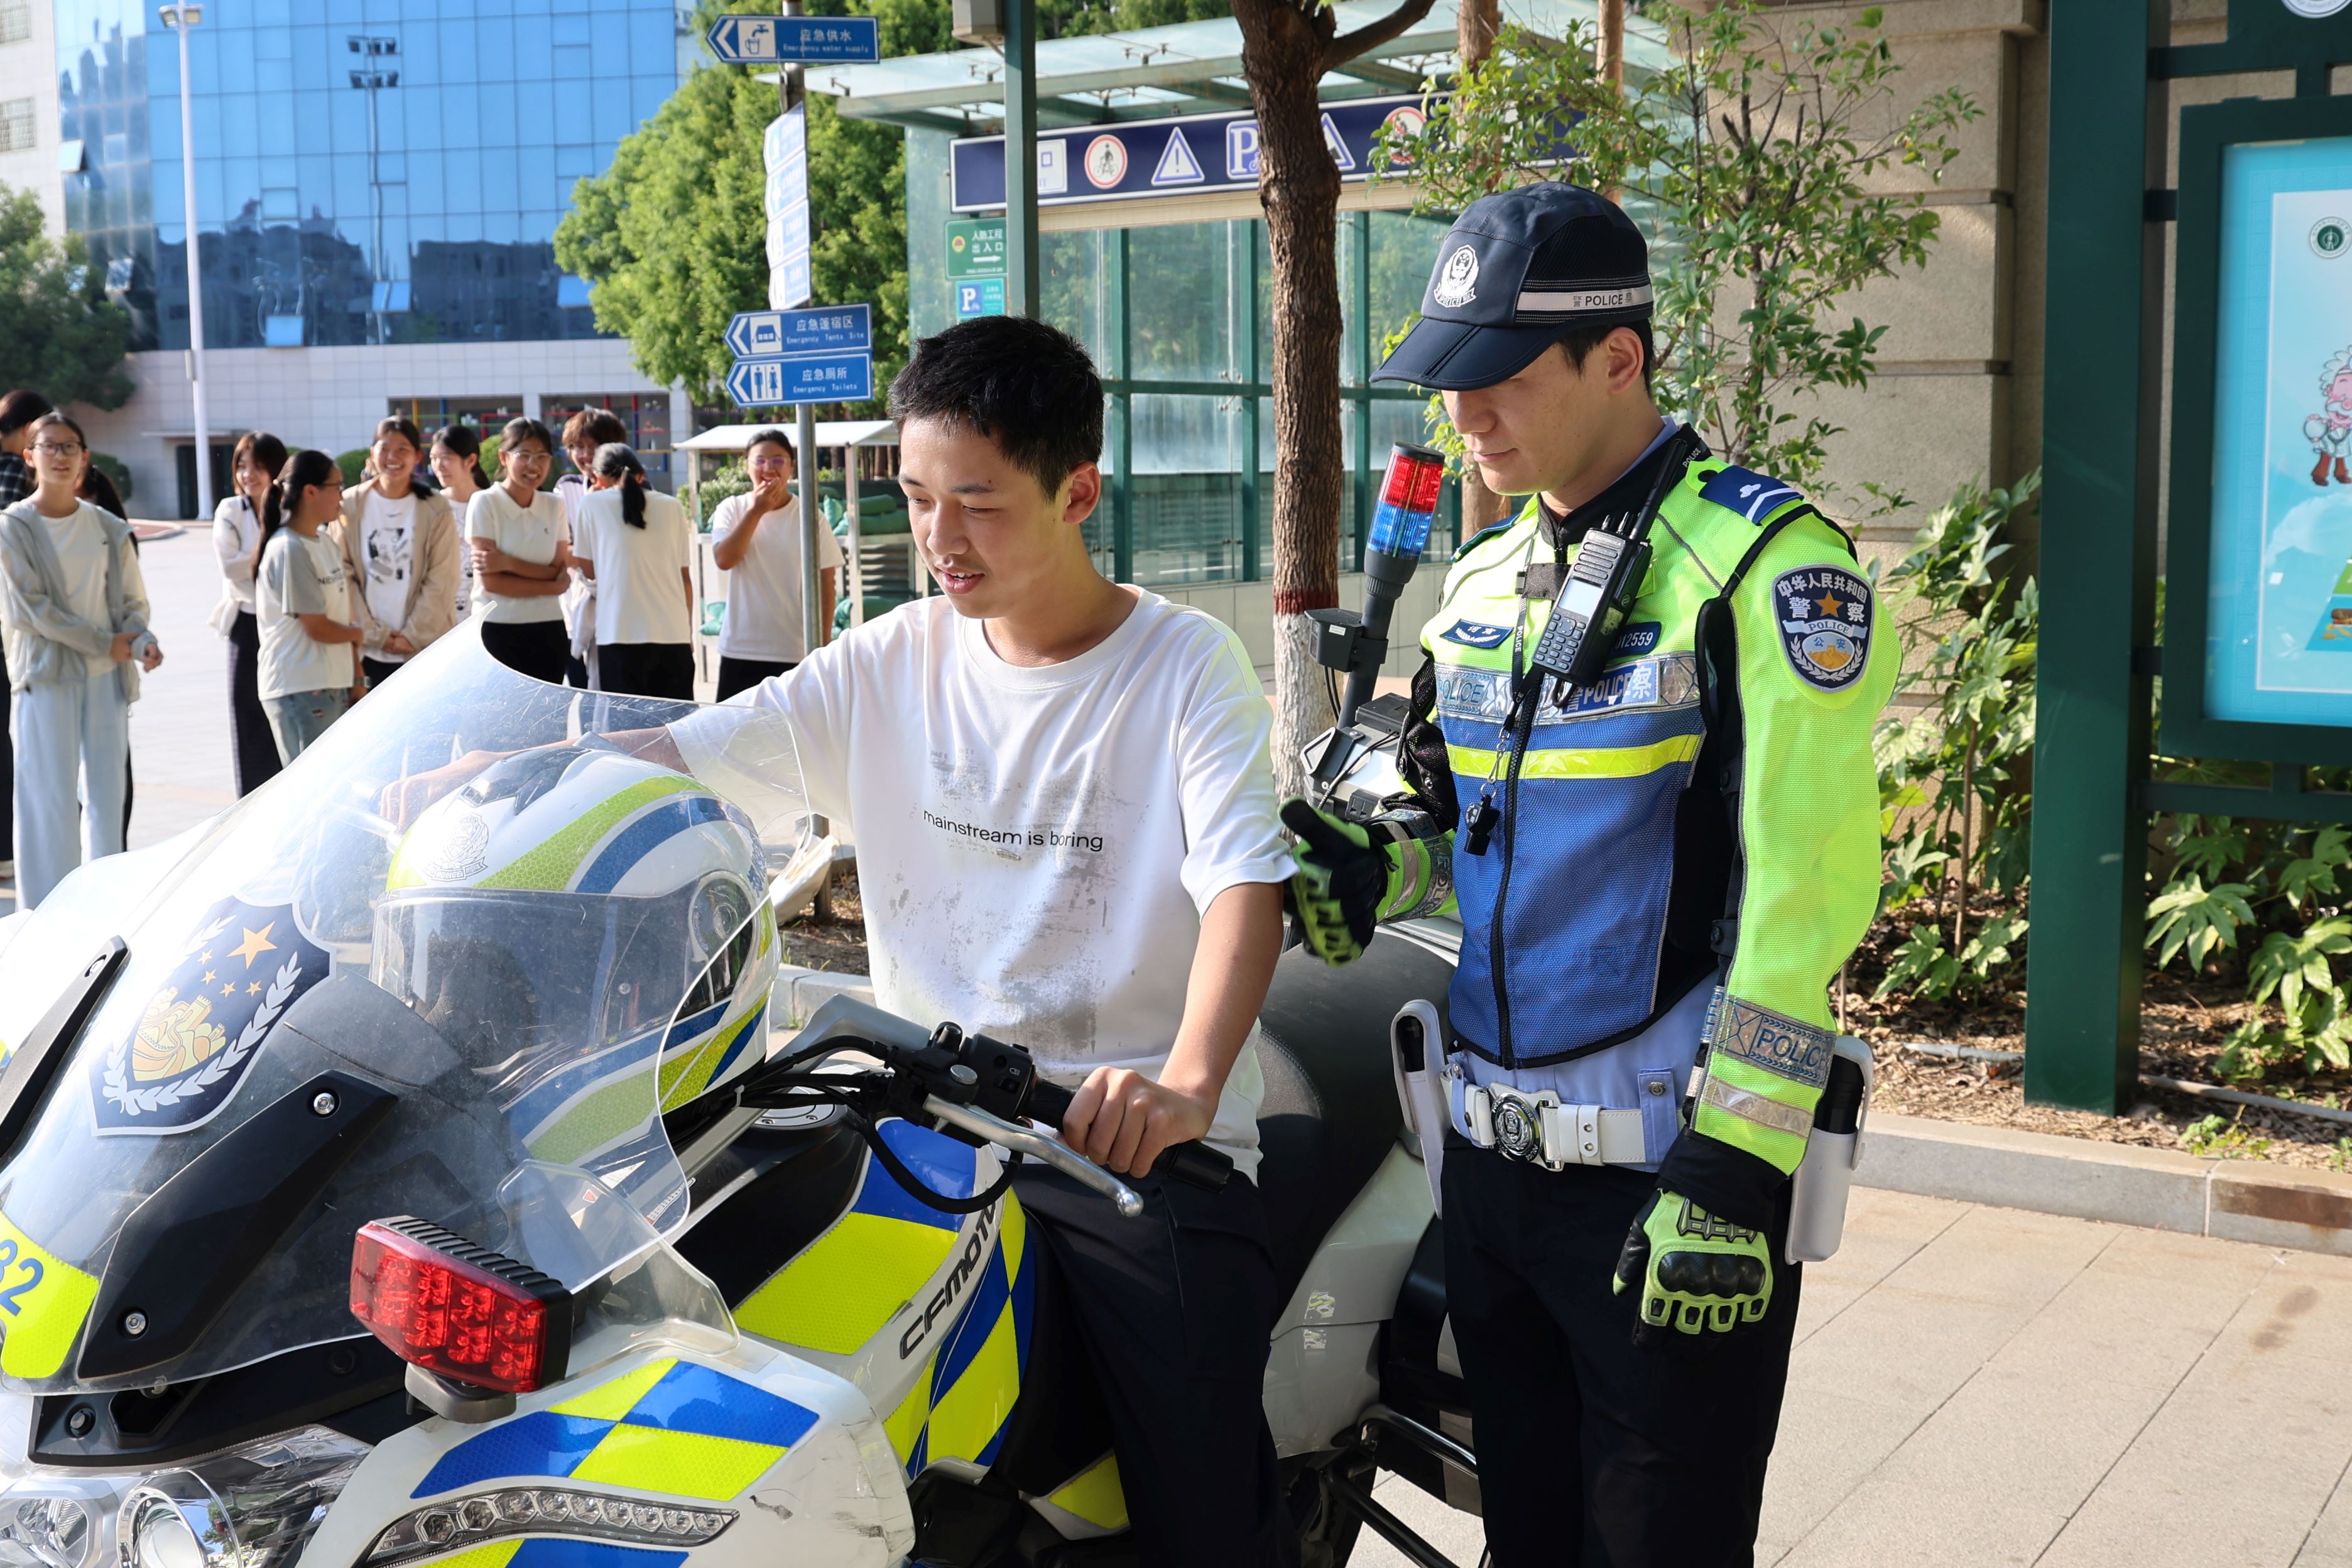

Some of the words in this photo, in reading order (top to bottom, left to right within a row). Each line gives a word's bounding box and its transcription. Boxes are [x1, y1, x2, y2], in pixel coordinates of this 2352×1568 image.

[800, 29, 852, 42] 应急供水
[972, 242, 1003, 254] 出入口
[961, 288, 976, 312] P
[1585, 294, 1623, 307] POLICE
[802, 367, 847, 382] 应急厕所
[1777, 572, 1868, 604] 中华人民共和国
[1789, 597, 1811, 619] 警
[1847, 602, 1865, 623] 察
[1515, 625, 1523, 653] POLICE
[1808, 621, 1850, 634] POLICE
[1437, 678, 1484, 704] POLICE
[1583, 672, 1634, 705] POLICE
[1632, 665, 1652, 699] 察
[923, 809, 1022, 845] mainstream
[1028, 830, 1044, 846] is
[1050, 830, 1103, 852] boring
